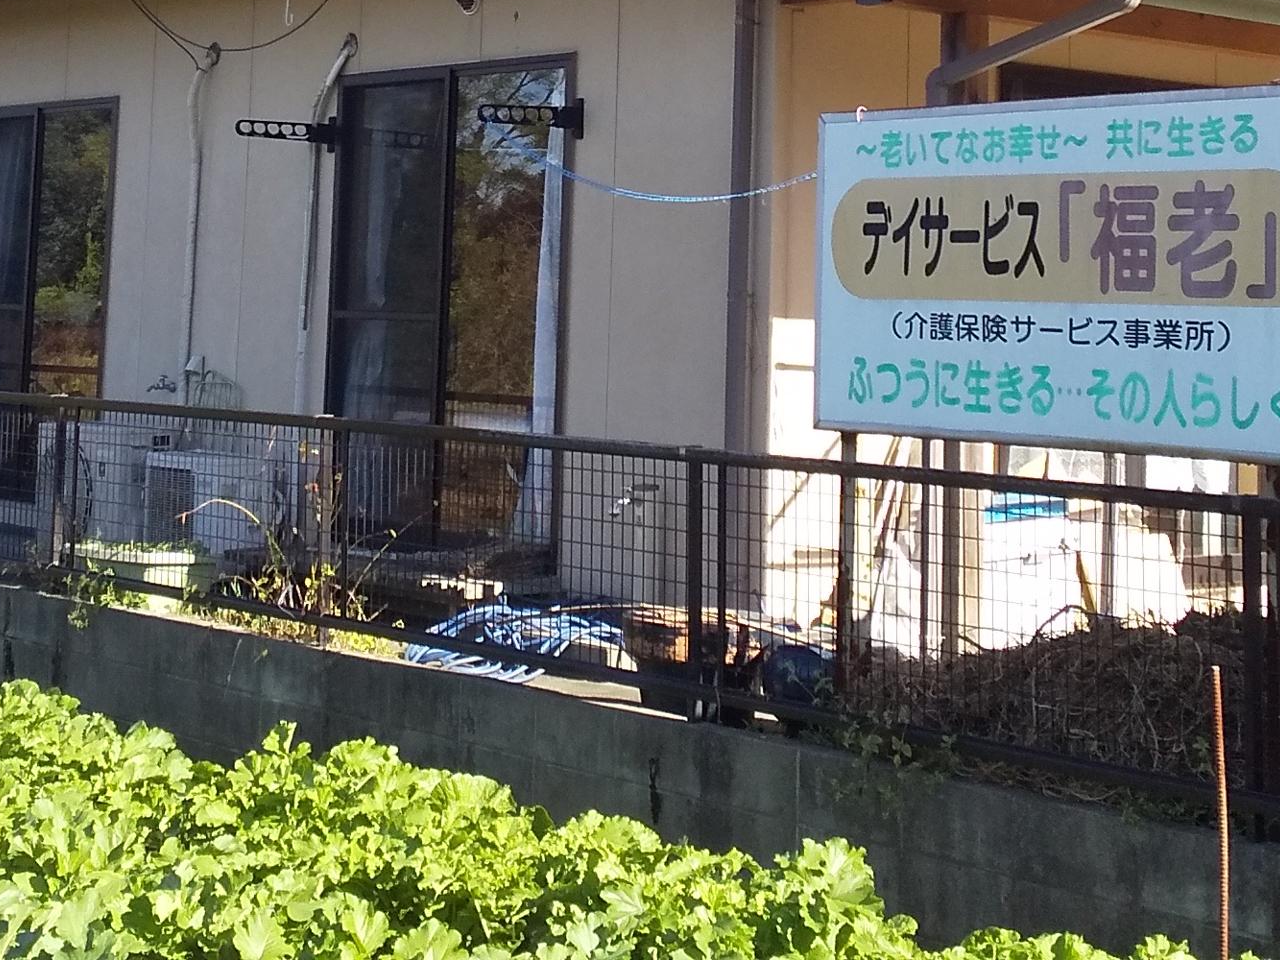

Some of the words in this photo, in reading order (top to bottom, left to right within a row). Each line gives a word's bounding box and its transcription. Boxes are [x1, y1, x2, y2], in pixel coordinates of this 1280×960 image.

[1106, 114, 1259, 159] 共に生きる
[862, 178, 1277, 301] デイサービス「福老」
